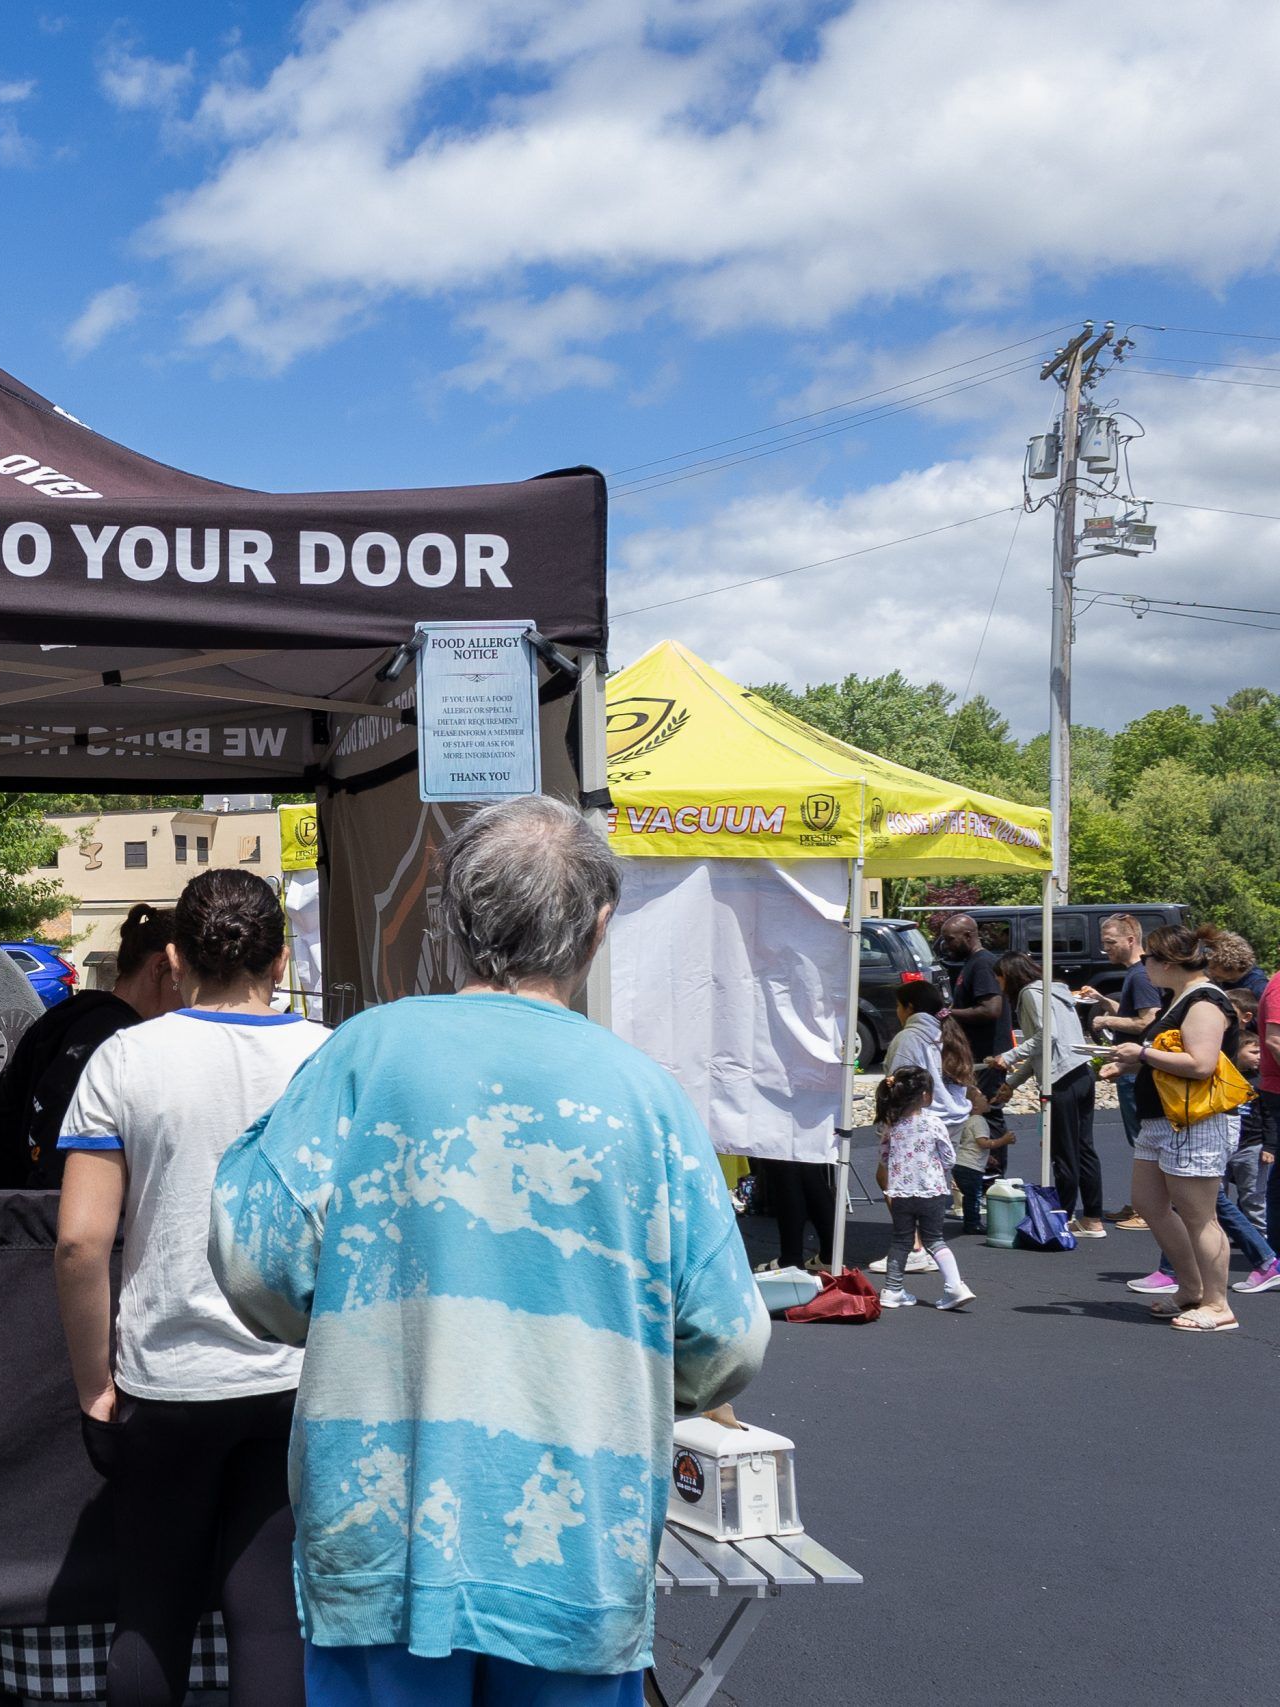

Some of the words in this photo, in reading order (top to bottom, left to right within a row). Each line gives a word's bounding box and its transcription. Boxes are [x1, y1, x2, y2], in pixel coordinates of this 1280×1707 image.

[71, 525, 277, 584] YOUR
[299, 531, 513, 588] DOOR
[431, 639, 465, 649] FOOD
[468, 637, 519, 648] ALLERGY
[454, 649, 499, 660] NOTICE
[468, 718, 519, 726] REQUIREMENT
[433, 729, 457, 737] PLEASE
[465, 751, 516, 759] INFORMATION
[450, 772, 487, 782] THANK
[488, 772, 511, 781] YOU
[813, 801, 830, 819] P
[626, 806, 786, 834] VACUUM
[304, 822, 317, 838] P
[887, 811, 930, 836] HOME
[946, 810, 967, 834] THE
[968, 811, 997, 840] FREE
[995, 819, 1042, 850] VACUUM
[800, 832, 843, 844] prestige
